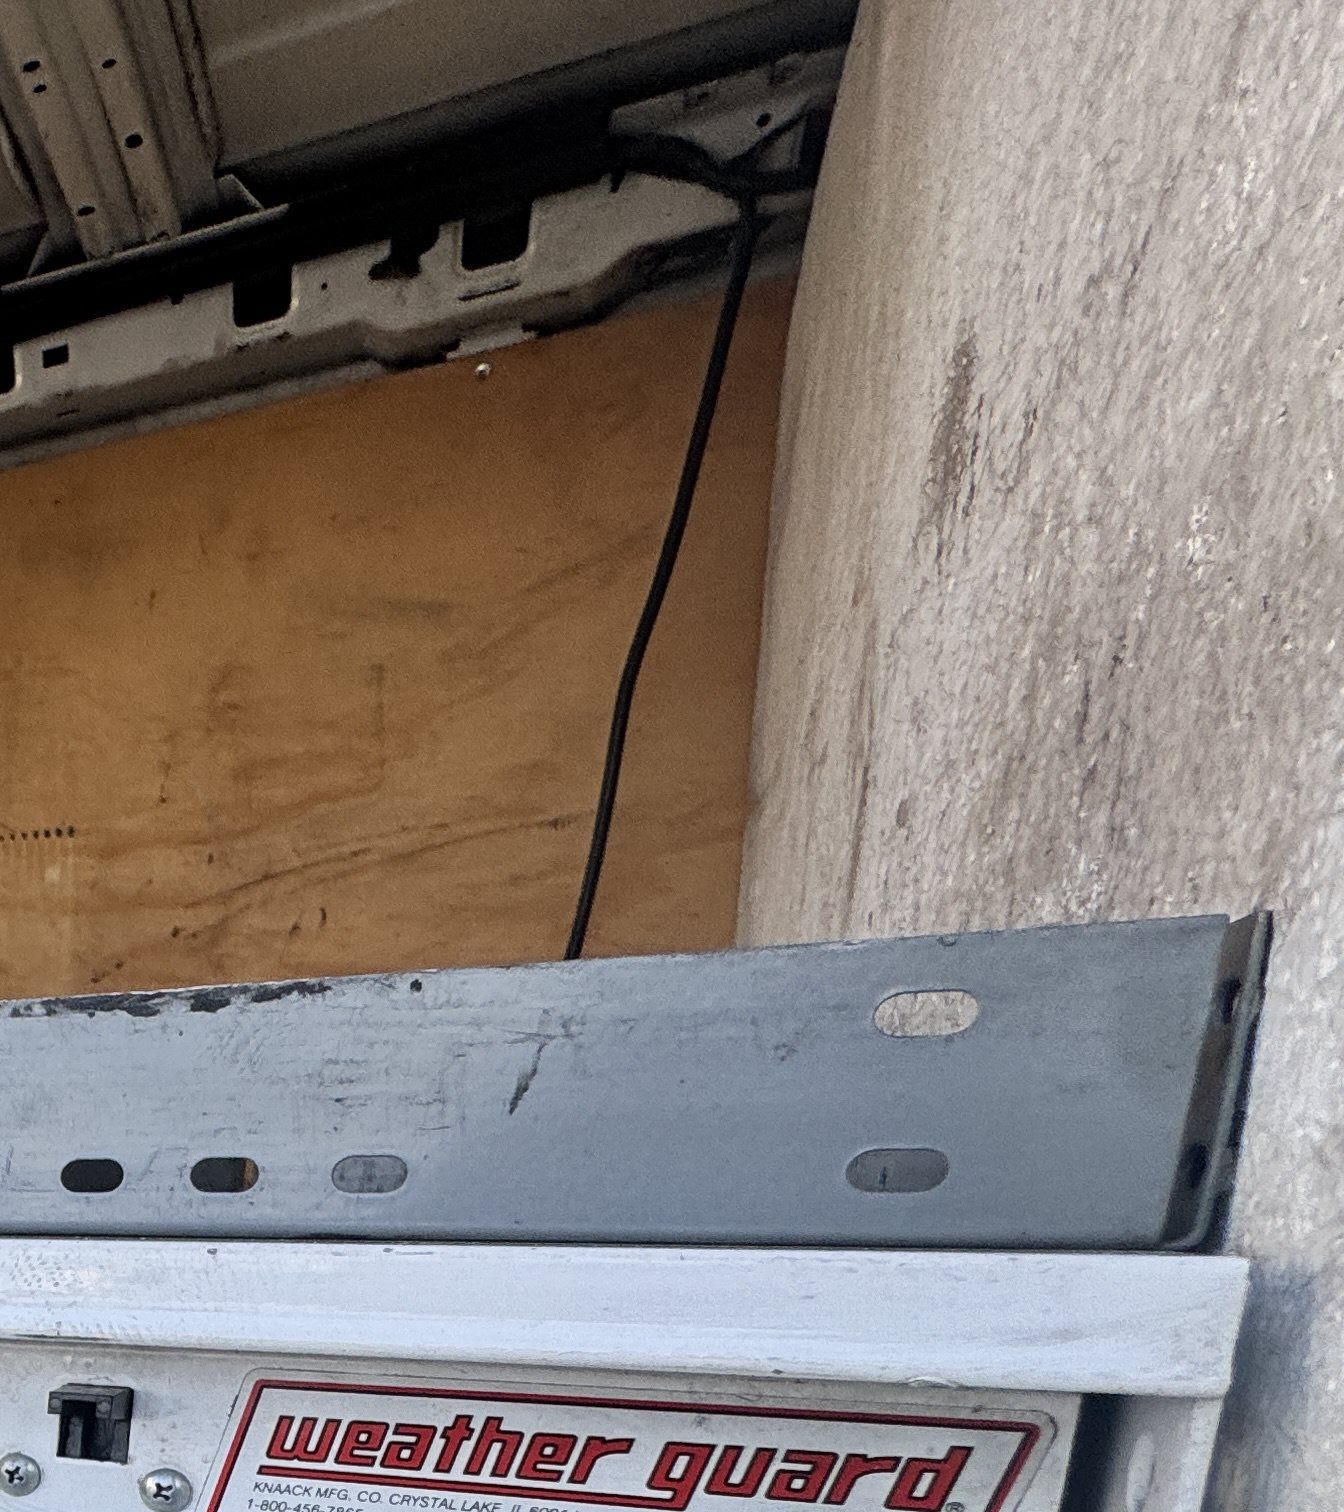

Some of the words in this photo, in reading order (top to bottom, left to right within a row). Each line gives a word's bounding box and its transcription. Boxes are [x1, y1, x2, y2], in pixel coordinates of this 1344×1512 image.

[266, 1414, 636, 1485] weather
[252, 1481, 313, 1498] KNAACK
[315, 1486, 352, 1502] MFG.
[388, 1492, 458, 1511] CRYSTAL
